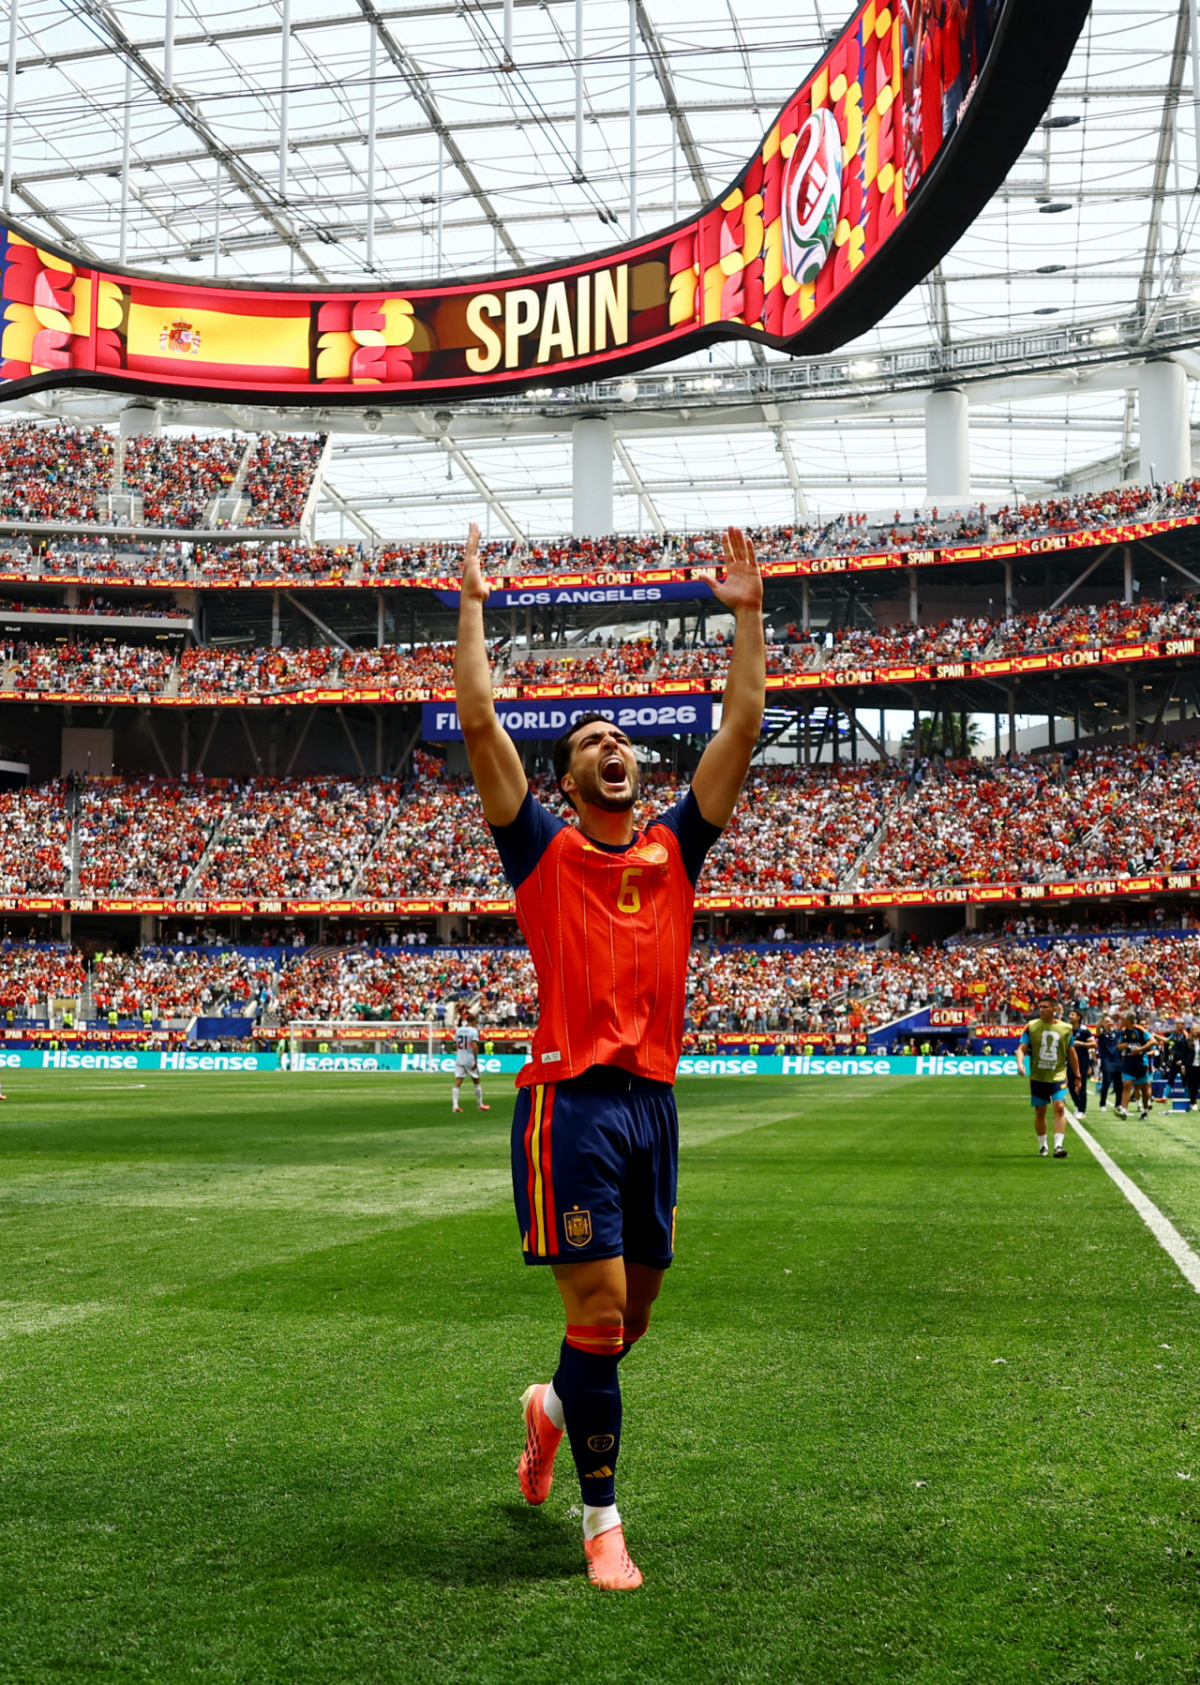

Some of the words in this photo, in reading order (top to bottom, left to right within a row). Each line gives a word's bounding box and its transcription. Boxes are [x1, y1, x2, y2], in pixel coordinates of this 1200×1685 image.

[465, 263, 629, 373] SPAIN
[1030, 537, 1067, 552] GOAL!
[810, 558, 846, 572] GOAL!
[907, 551, 935, 565] SPAIN
[596, 572, 632, 585] GOAL!
[690, 568, 717, 580] SPAIN
[506, 592, 550, 606] LOS
[556, 588, 662, 603] ANGELES
[1165, 639, 1195, 655] SPAIN
[1062, 651, 1100, 666] GOAL!
[836, 670, 873, 684] GOAL!
[937, 664, 965, 678] SPAIN
[395, 689, 430, 700] GOAL!
[492, 687, 518, 699] SPAIN
[613, 682, 650, 695] GOAL!
[436, 713, 461, 730] FI
[570, 709, 615, 727] CP
[619, 705, 697, 726] 2026
[1086, 881, 1116, 894] GOAL!
[1167, 875, 1191, 889] SPAIN
[617, 867, 643, 913] 6
[936, 890, 967, 902] GOAL!
[1021, 886, 1045, 898] SPAIN
[70, 899, 93, 911] SPAIN
[176, 901, 206, 912] GOAL!
[259, 901, 282, 912] SPAIN
[364, 901, 395, 912] GOAL!
[448, 901, 471, 912] SPAIN
[744, 896, 775, 907] GOAL!
[829, 894, 854, 906] SPAIN
[457, 1035, 468, 1050] 21
[42, 1051, 138, 1069] Hisense
[160, 1052, 258, 1070] Hisense
[676, 1058, 758, 1074] sense
[782, 1056, 890, 1075] Hisense
[915, 1056, 1018, 1075] Hisense
